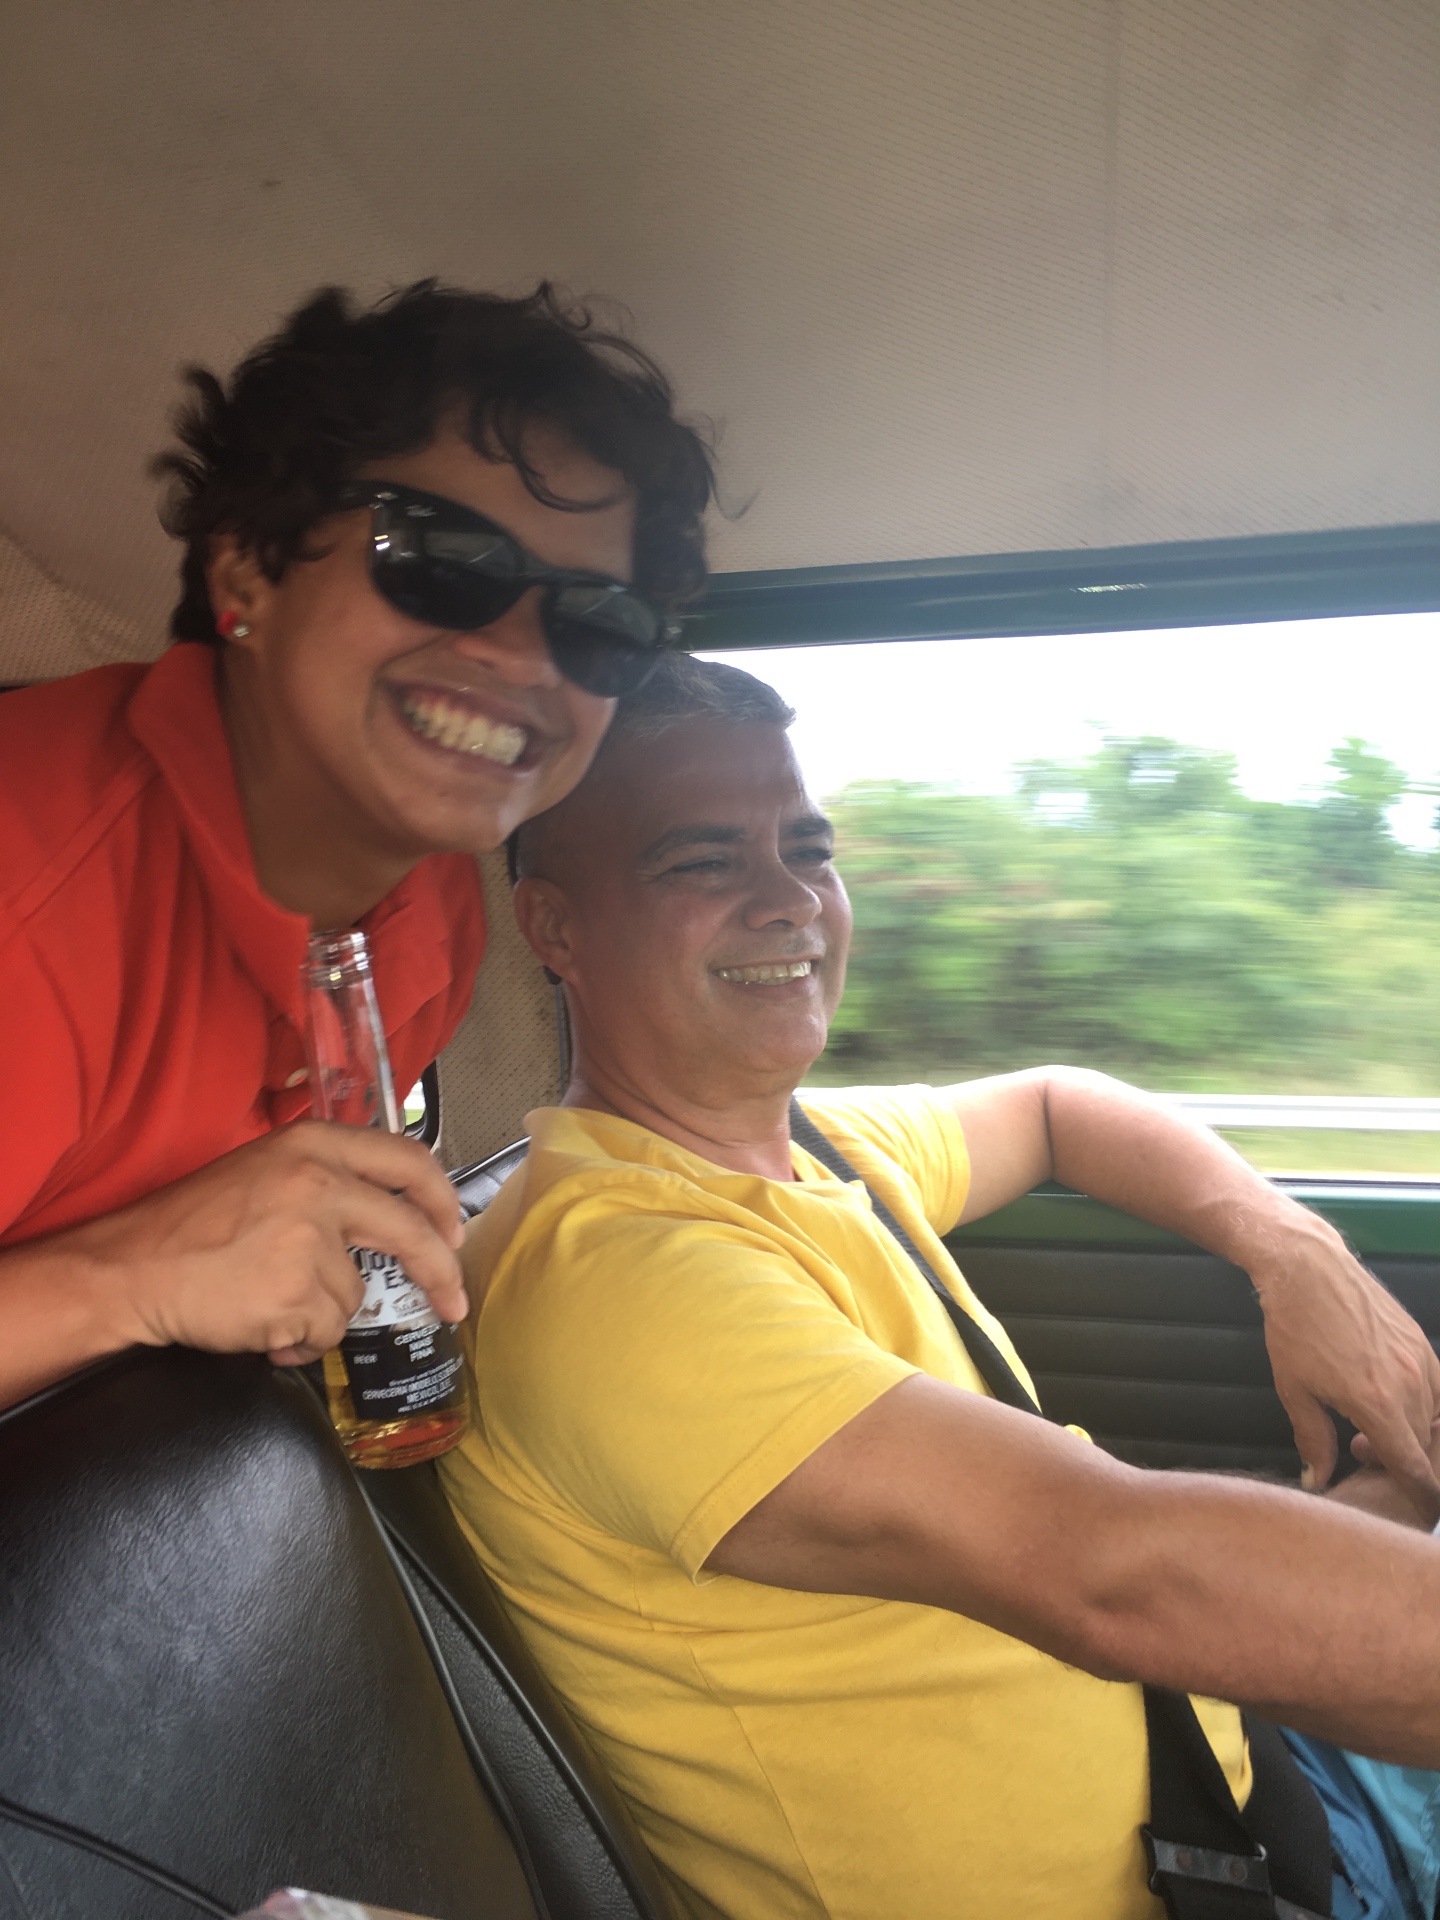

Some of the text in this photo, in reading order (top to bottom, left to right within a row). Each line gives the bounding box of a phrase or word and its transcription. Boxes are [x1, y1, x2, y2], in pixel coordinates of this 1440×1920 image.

[394, 1323, 442, 1345] CERVEZA
[354, 1354, 378, 1364] BEER
[362, 1385, 407, 1400] CERVECERIA
